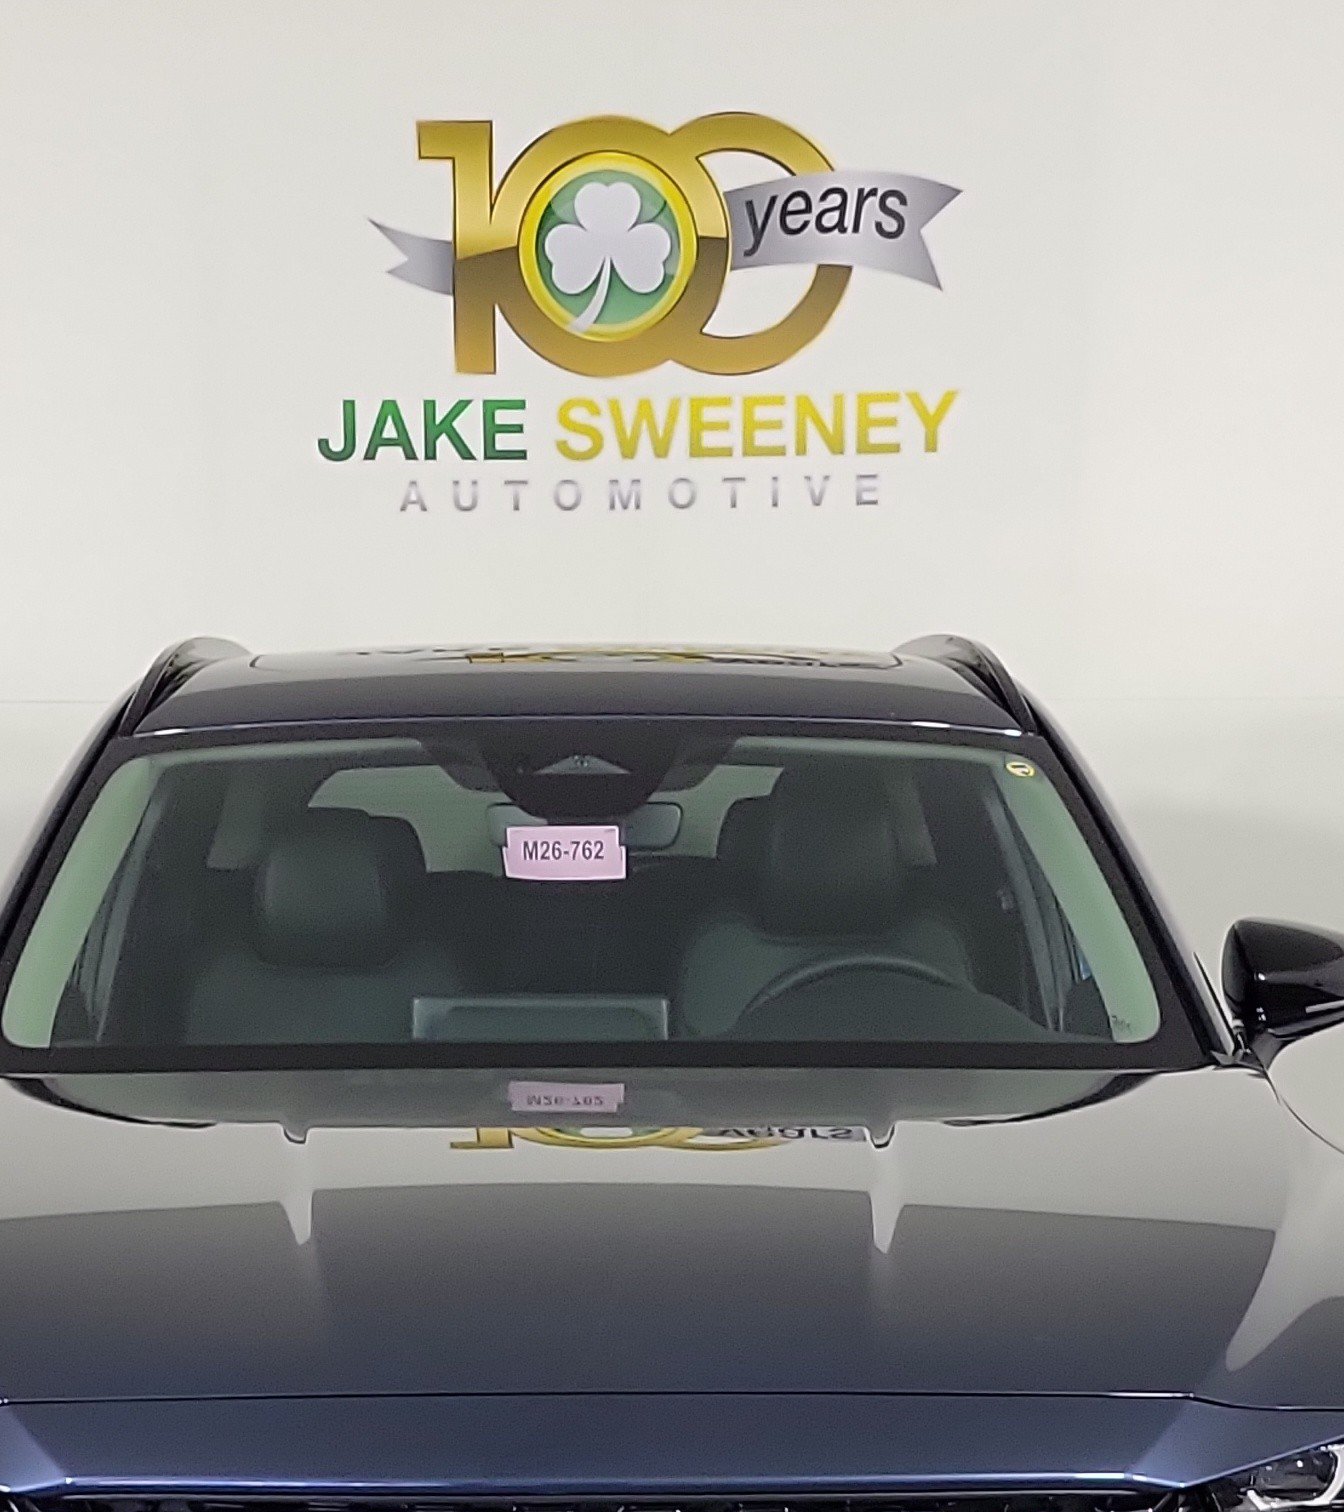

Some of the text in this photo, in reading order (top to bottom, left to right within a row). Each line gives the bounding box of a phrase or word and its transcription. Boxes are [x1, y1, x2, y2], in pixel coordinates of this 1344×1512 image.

[416, 112, 908, 376] 100 years
[317, 390, 959, 462] JAKE SWEENEY
[400, 474, 881, 513] AUTOMOTIVE
[523, 840, 604, 860] M26-762
